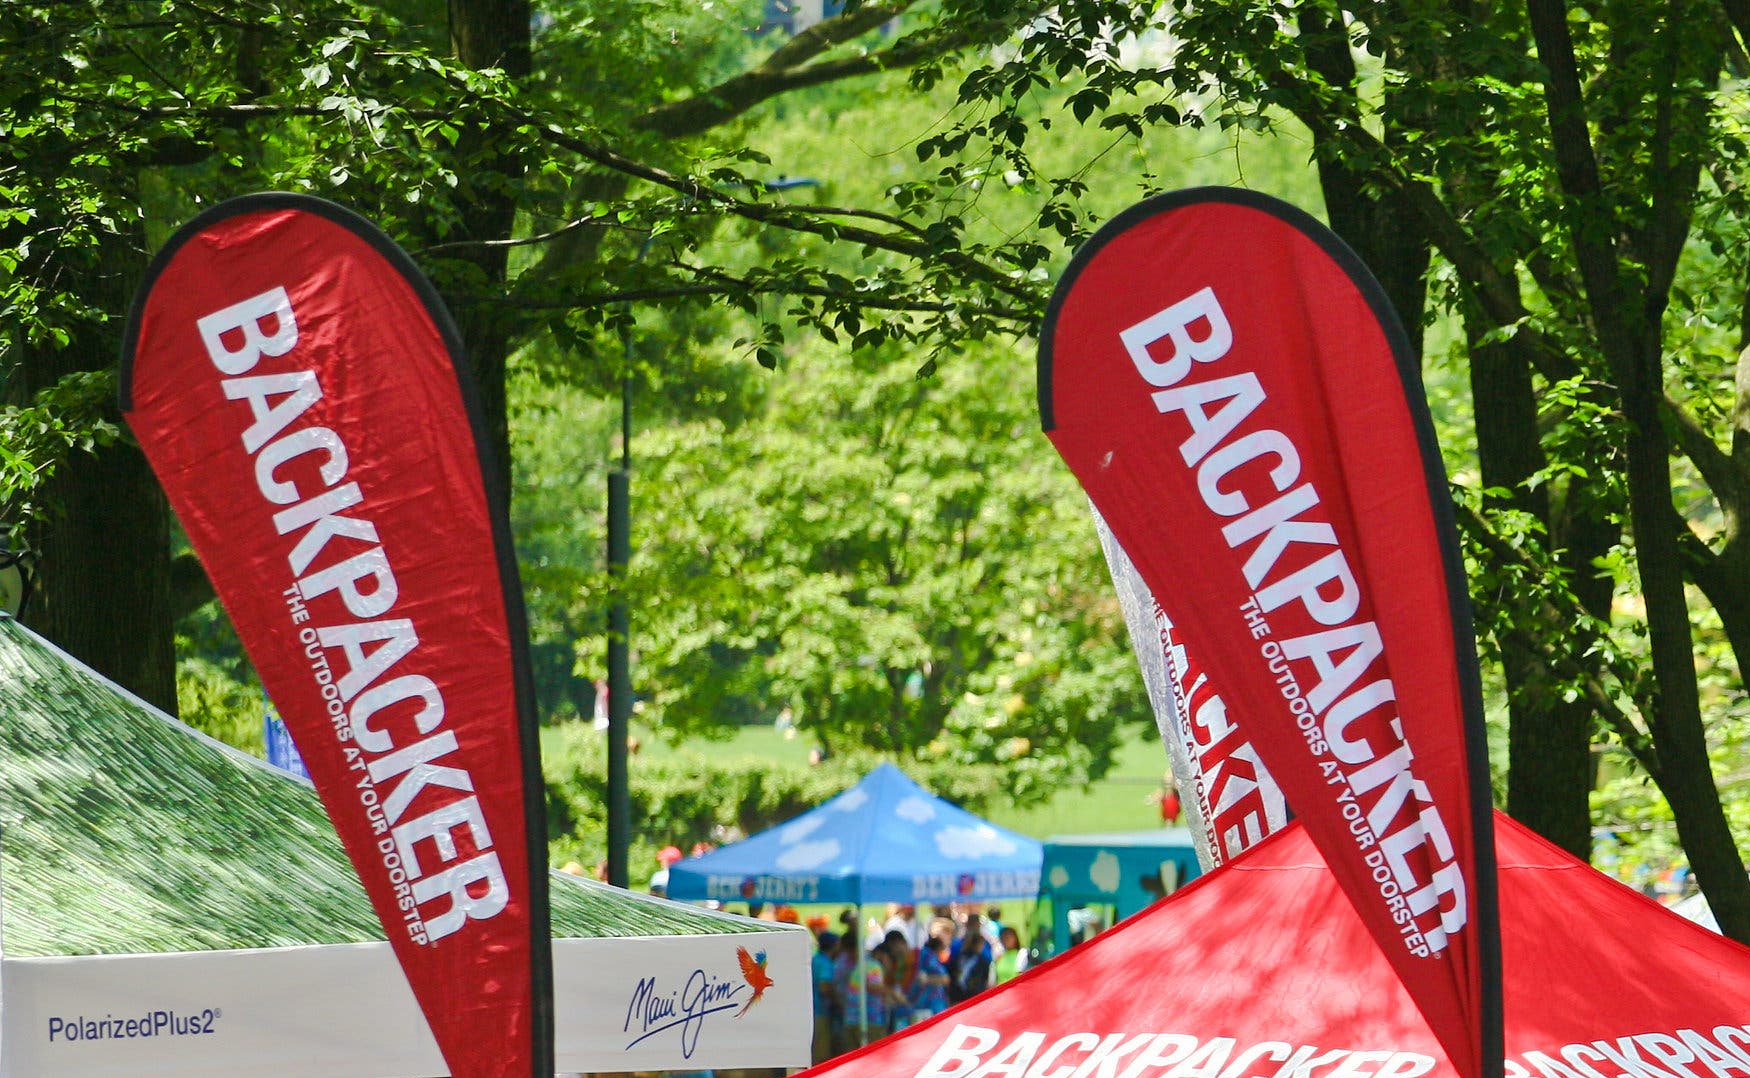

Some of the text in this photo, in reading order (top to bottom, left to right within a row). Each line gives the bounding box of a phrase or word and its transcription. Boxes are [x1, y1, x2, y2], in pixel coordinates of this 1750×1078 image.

[197, 285, 510, 942] BACKPACKER
[282, 584, 429, 948] THE OUTDOORS AT YOUR DOORSTEP
[1119, 286, 1467, 953] BACKPACKER
[1159, 629, 1191, 737] OUTDOORS
[1185, 741, 1199, 765] AT
[1193, 765, 1211, 826] YOUR
[1239, 596, 1431, 960] THE OUTDOORS AT YOUR DOORSTEP
[624, 969, 746, 1060] Maui Jim
